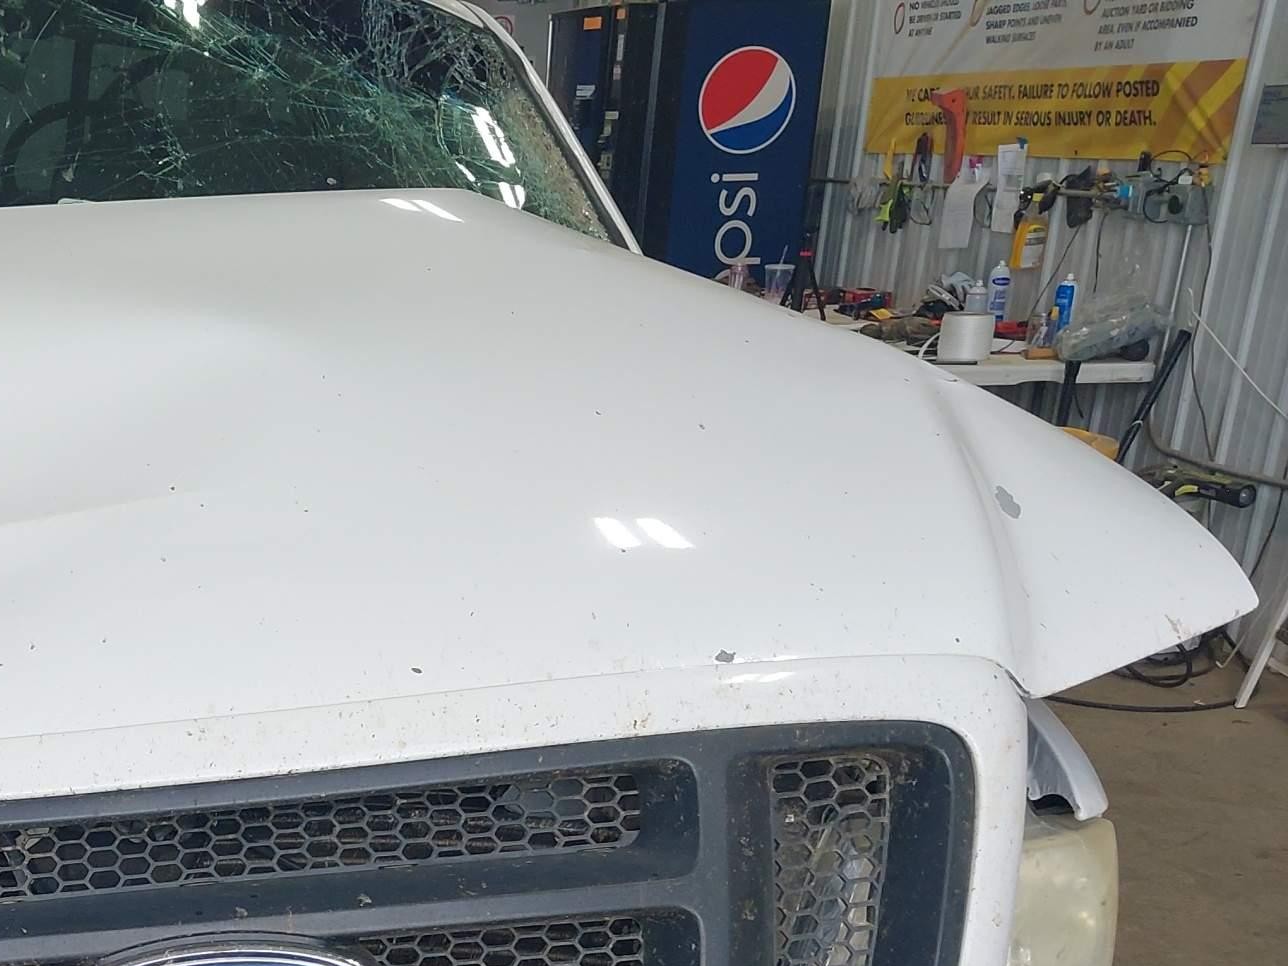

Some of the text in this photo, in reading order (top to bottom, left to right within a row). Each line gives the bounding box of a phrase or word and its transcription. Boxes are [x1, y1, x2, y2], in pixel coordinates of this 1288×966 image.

[909, 2, 920, 10] NO
[986, 4, 1011, 15] JAGGED
[1160, 0, 1195, 12] BIDDING
[986, 19, 1006, 30] SHARP
[1142, 15, 1198, 31] ACCOMPANIED
[1114, 38, 1135, 50] ADULT
[982, 84, 1015, 100] SAFETY.
[1017, 84, 1054, 99] FAILURE
[1057, 83, 1070, 99] TO
[1071, 81, 1113, 98] FOLLOW
[1116, 80, 1161, 98] POSTED
[973, 111, 1002, 125] RESULT
[1002, 111, 1014, 125] IN
[1014, 111, 1052, 126] SERIOUS
[1055, 110, 1093, 126] INJURY
[1096, 110, 1111, 126] OR
[1114, 110, 1157, 126] DEATH.
